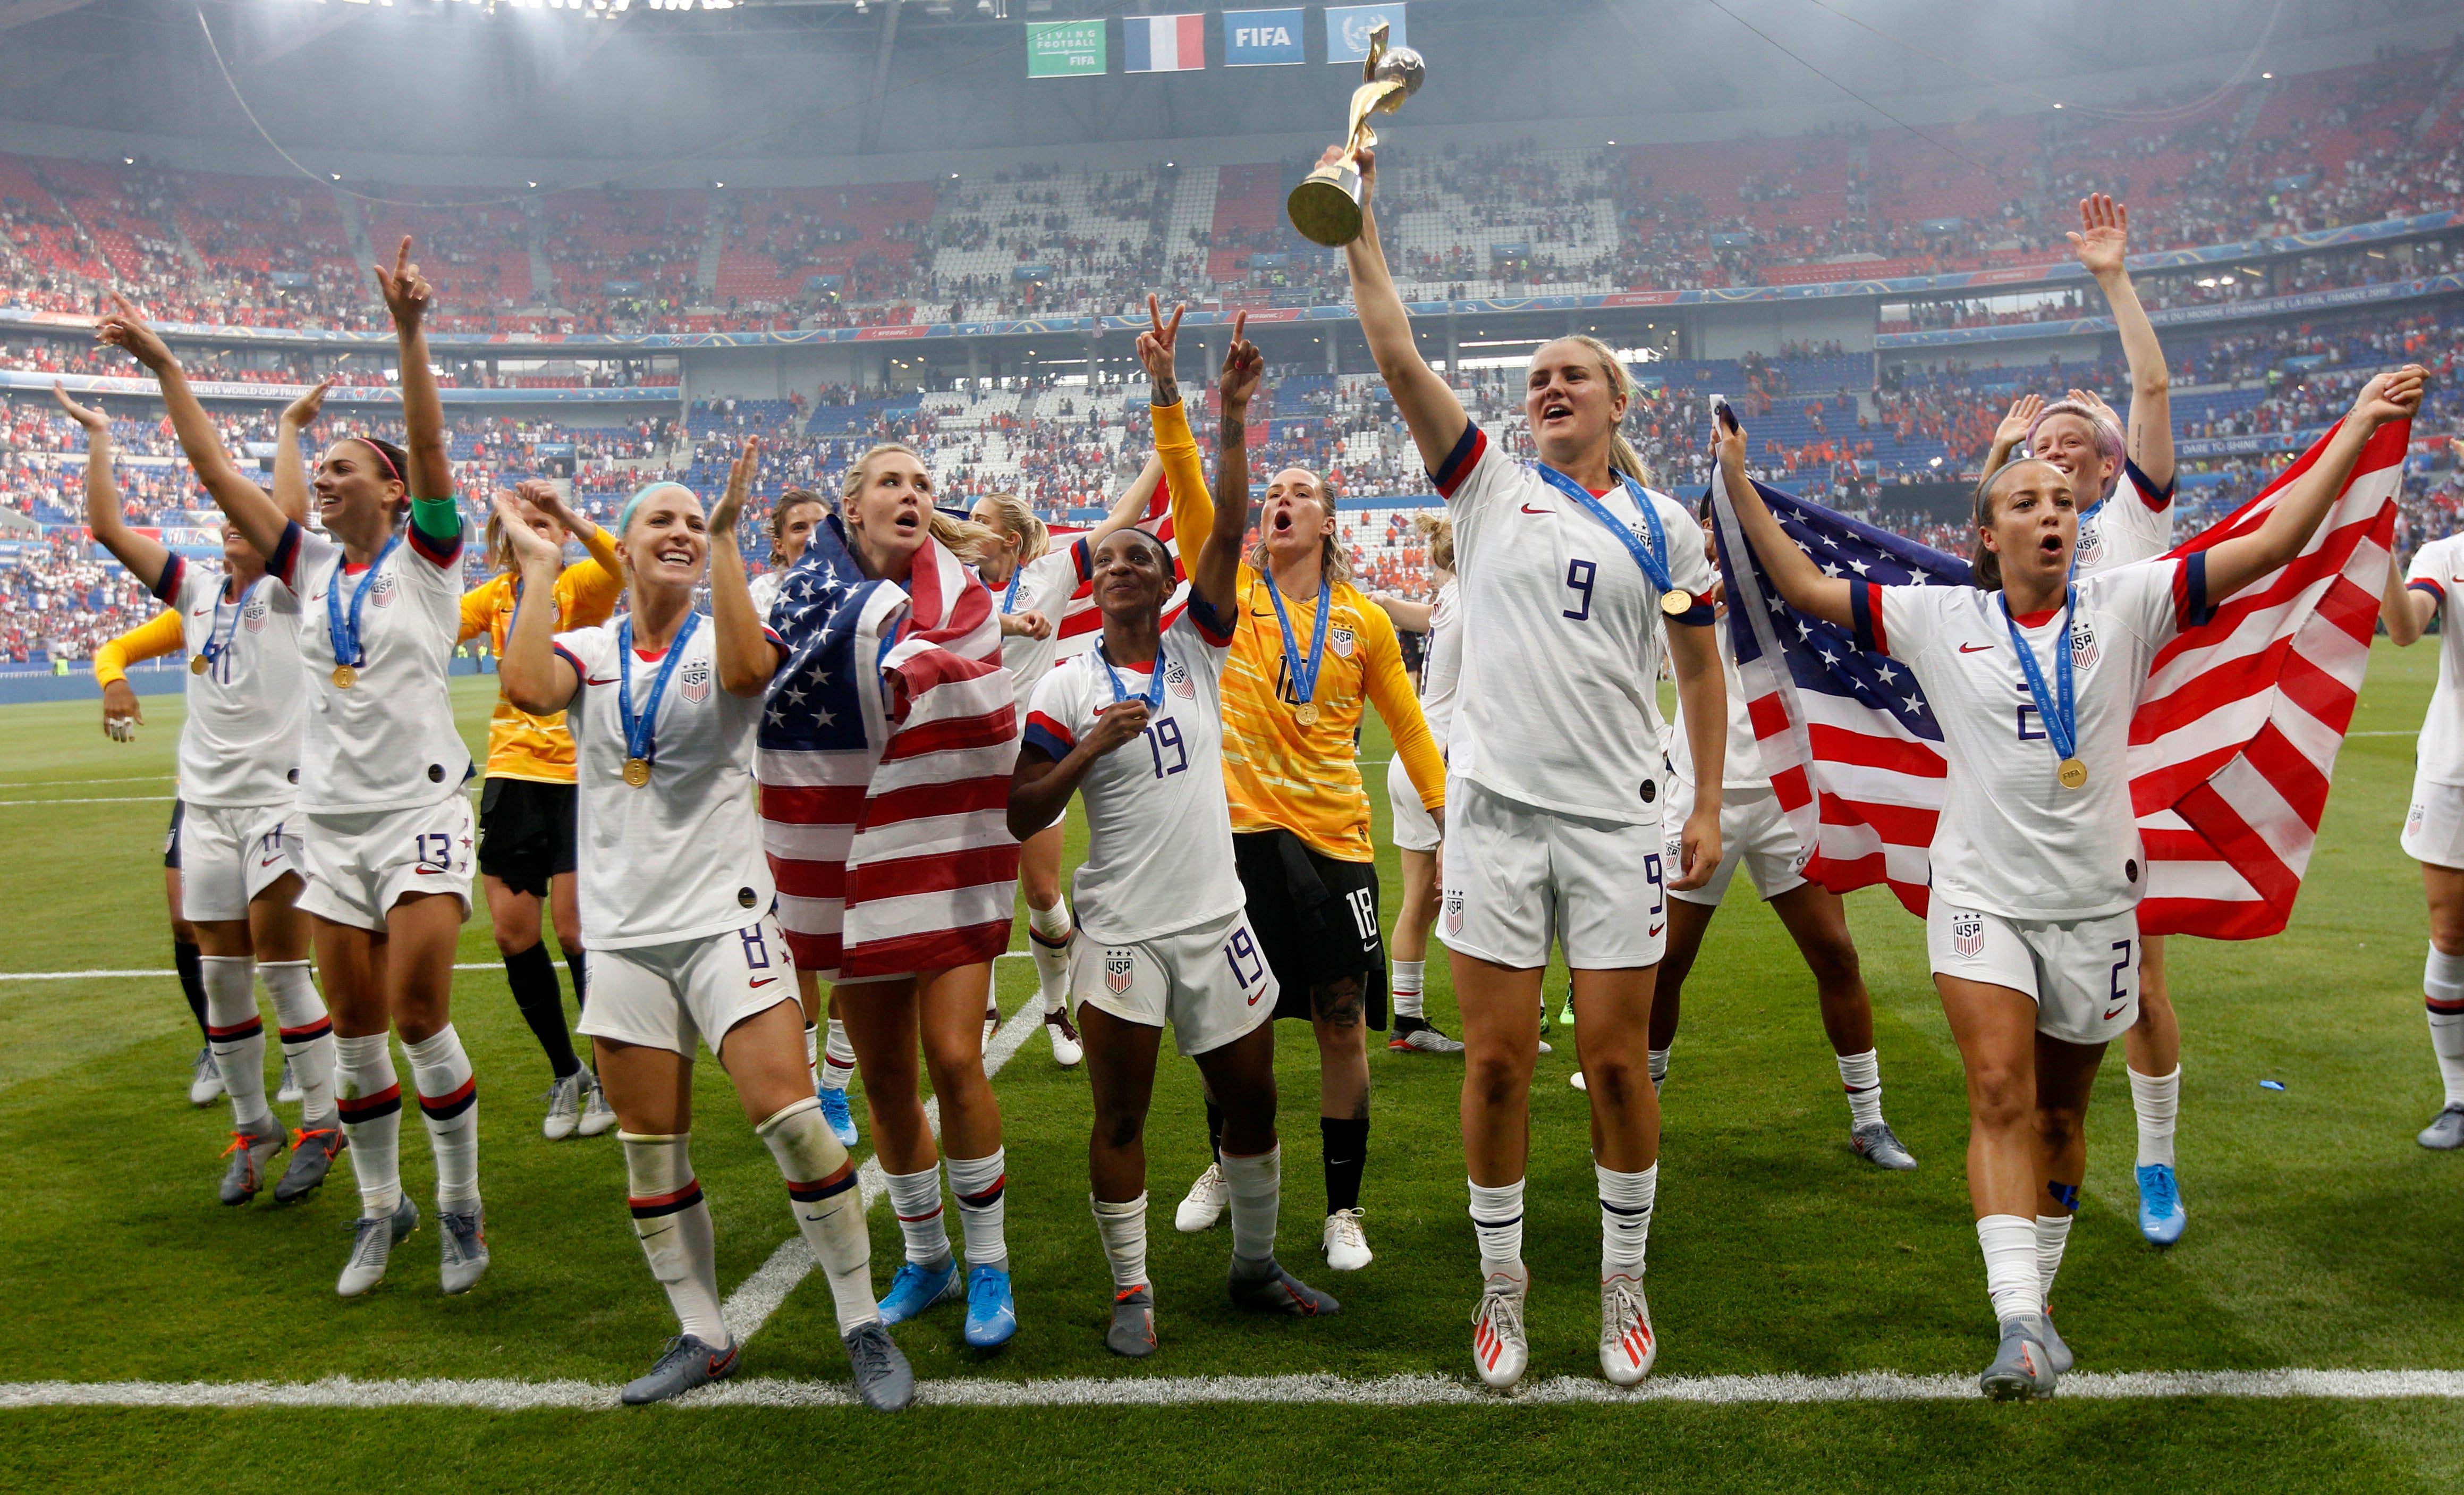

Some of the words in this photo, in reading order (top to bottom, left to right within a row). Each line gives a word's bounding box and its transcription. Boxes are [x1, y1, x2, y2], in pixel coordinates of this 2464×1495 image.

[1037, 30, 1096, 40] LIVING
[1236, 27, 1292, 47] FIFA
[1037, 38, 1096, 48] FOOTBALL
[1070, 55, 1096, 65] FIFA
[2327, 291, 2365, 302] FRANCE
[223, 386, 257, 395] WORLD
[2182, 444, 2209, 454] DARE
[2212, 442, 2225, 452] TO
[2226, 440, 2258, 451] SHINE
[2077, 538, 2097, 550] USA
[374, 580, 393, 593] USA
[1563, 559, 1597, 621] 9
[1015, 592, 1029, 600] USA
[246, 609, 264, 619] USA
[1333, 629, 1351, 642] USA
[2019, 642, 2027, 654] FIFA
[2025, 660, 2034, 672] FIFA
[683, 671, 707, 685] USA
[1165, 669, 1186, 685] USA
[2032, 678, 2040, 691] FIFA
[2017, 683, 2046, 740] 2
[2047, 717, 2056, 730] FIFA
[1144, 716, 1188, 779] 19
[2056, 737, 2065, 749] FIFA
[2062, 769, 2081, 780] FIFA
[416, 833, 452, 870] 13
[1643, 852, 1663, 915] 9
[1345, 887, 1377, 940] 18
[1447, 900, 1461, 915] USA
[1956, 923, 1980, 937] USA
[739, 922, 770, 969] 8
[1223, 926, 1263, 990] 19
[1108, 960, 1131, 974] USA
[2111, 939, 2130, 1000] 2
